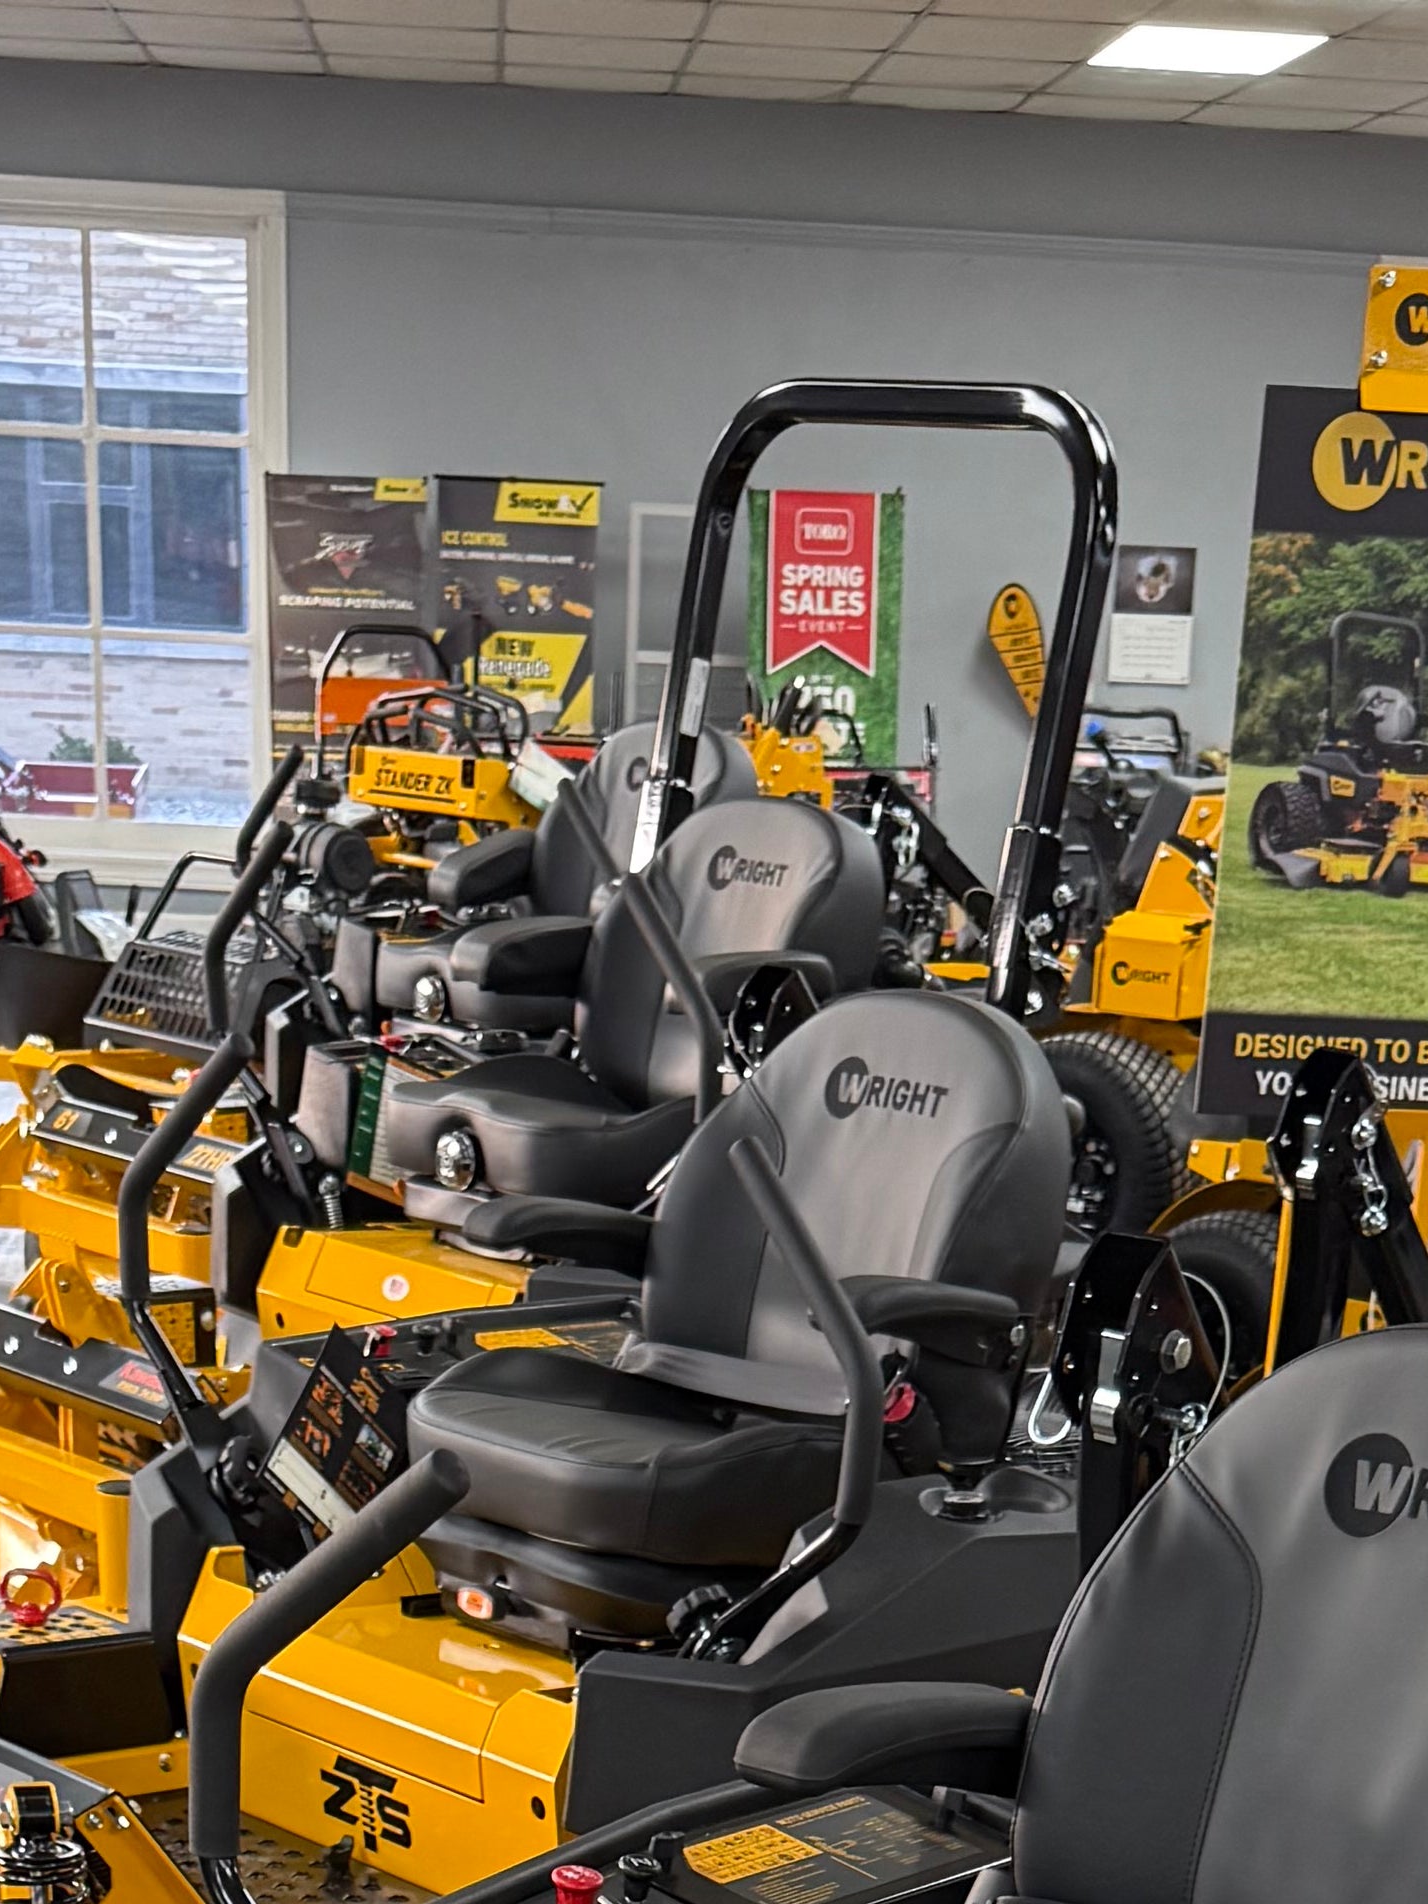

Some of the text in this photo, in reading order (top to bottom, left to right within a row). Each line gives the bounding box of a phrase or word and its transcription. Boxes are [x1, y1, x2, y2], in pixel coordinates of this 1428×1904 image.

[781, 563, 865, 588] SPRING
[779, 589, 866, 617] SALES
[798, 620, 846, 633] EVENT
[494, 637, 536, 657] NEW
[710, 848, 789, 889] WRIGHT
[1373, 1037, 1412, 1065] TO
[828, 1060, 949, 1120] WRIGHT
[51, 1110, 81, 1131] 61
